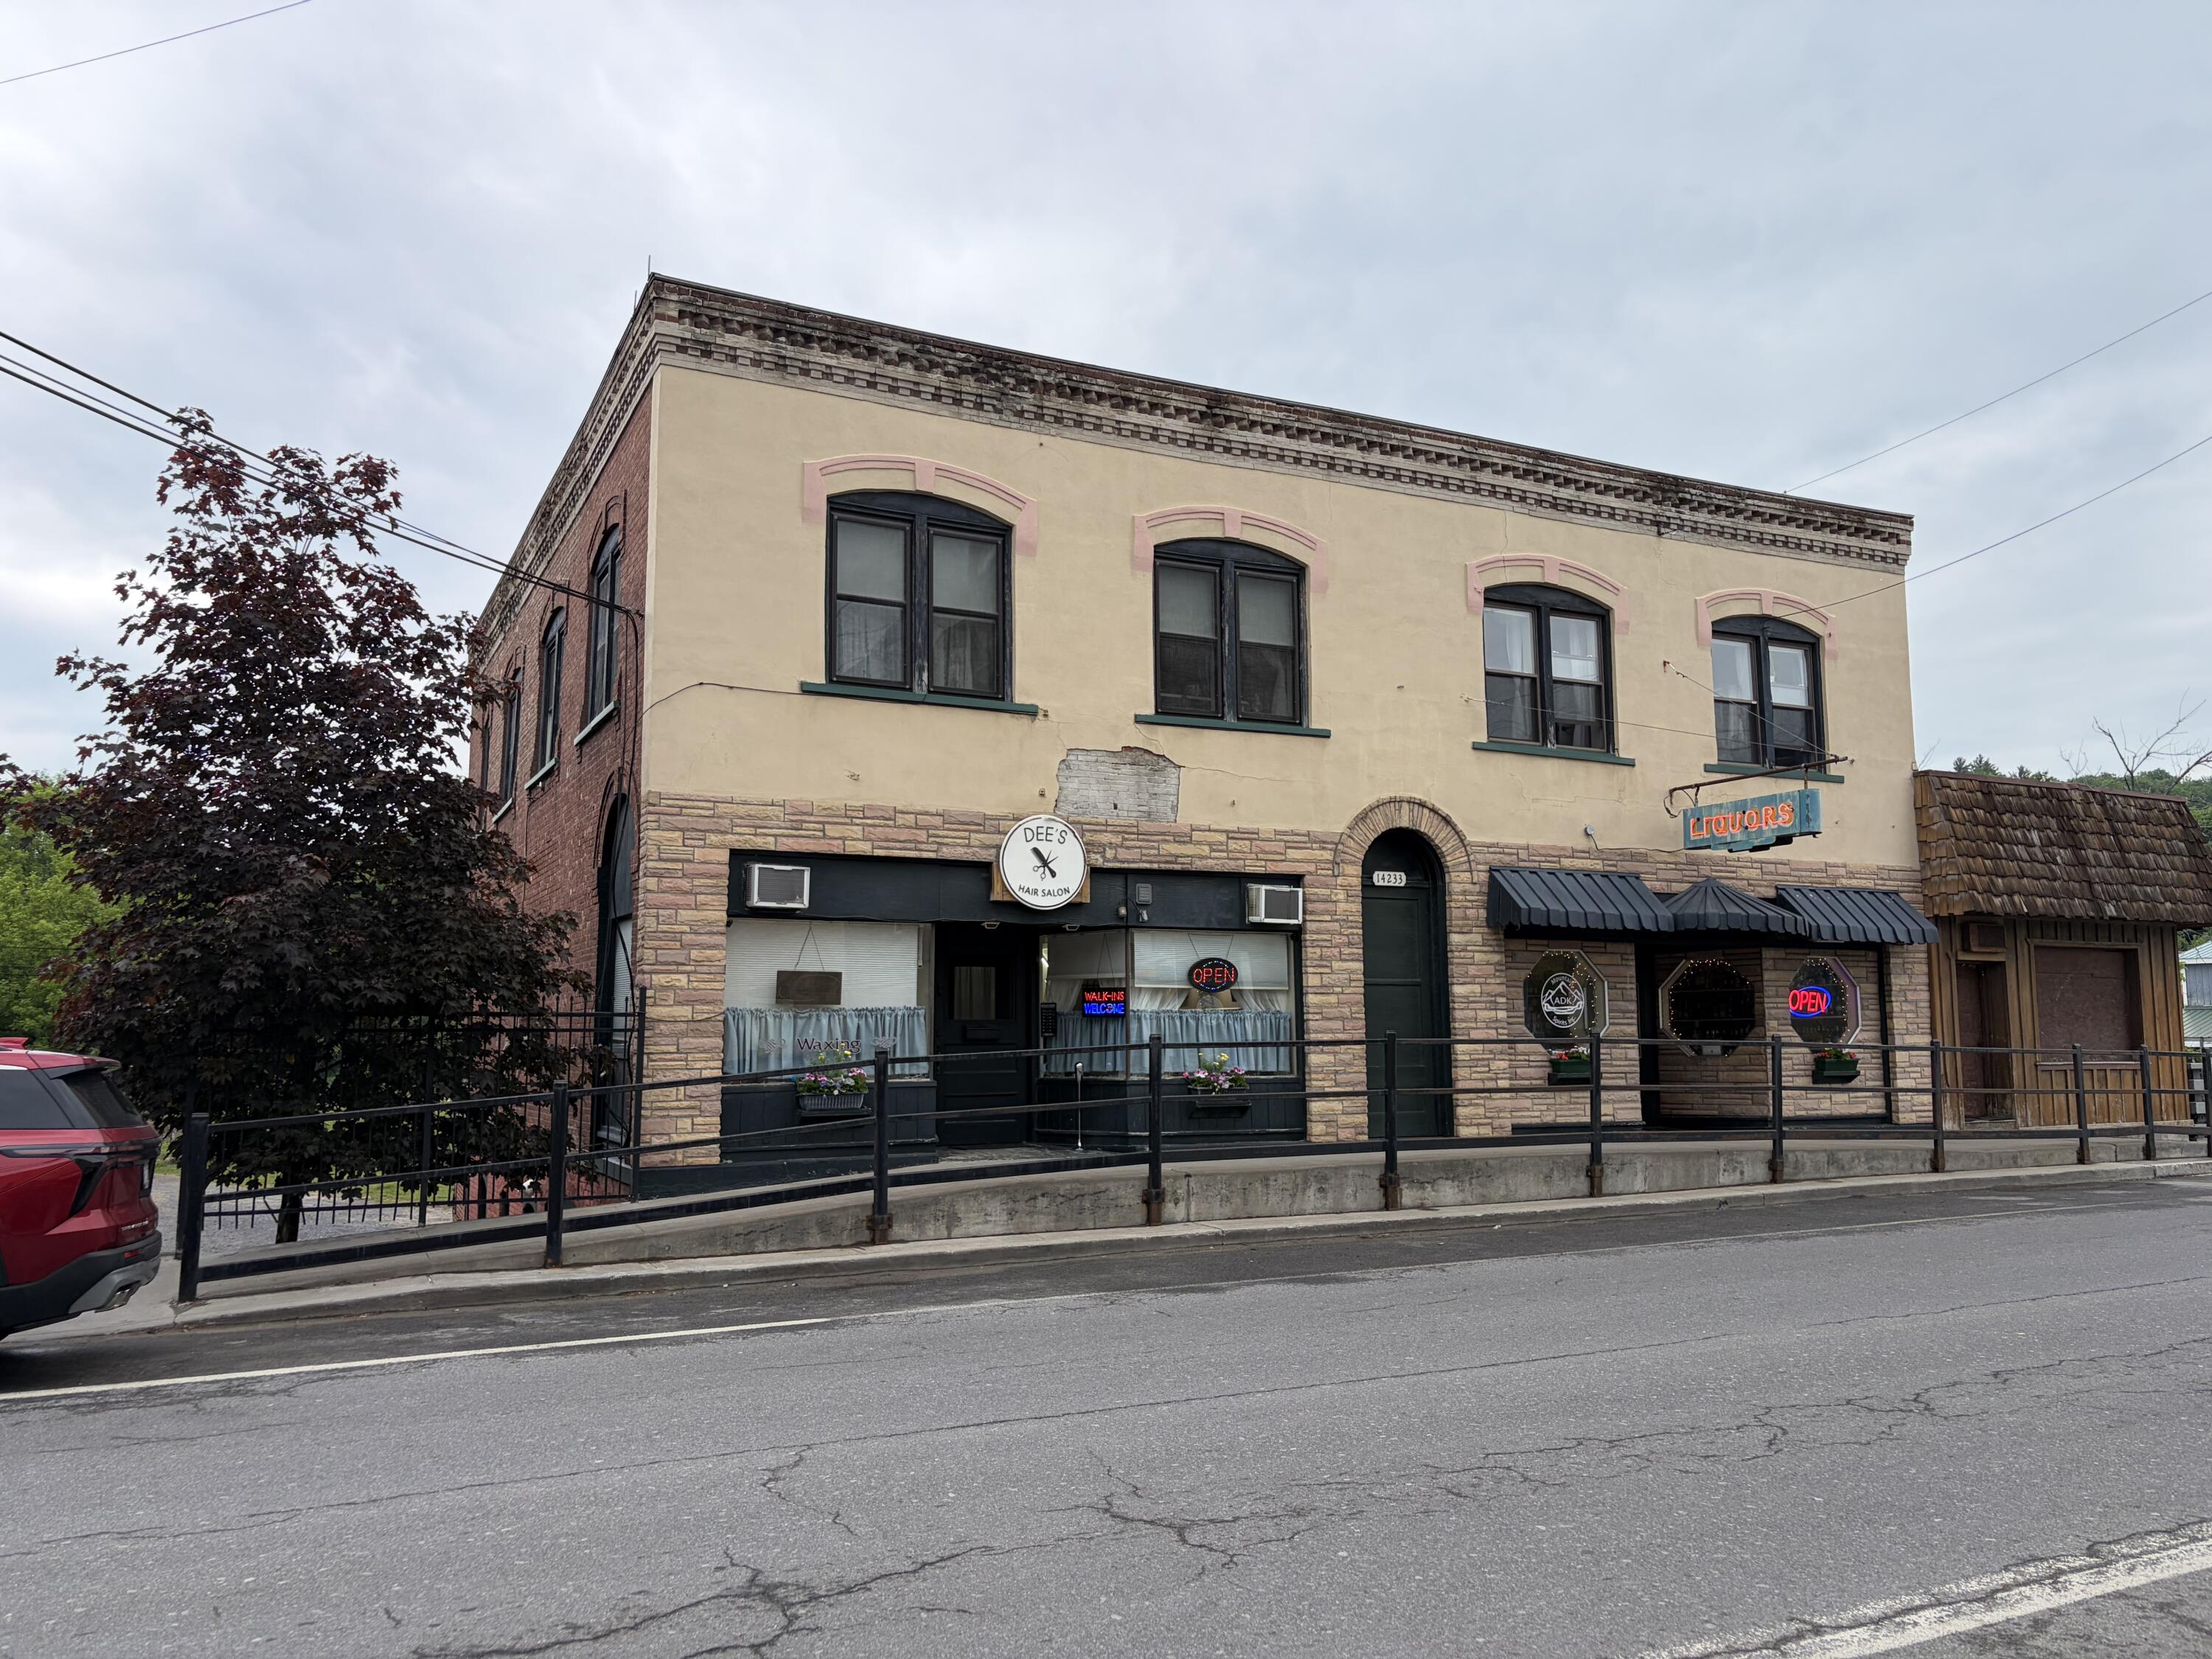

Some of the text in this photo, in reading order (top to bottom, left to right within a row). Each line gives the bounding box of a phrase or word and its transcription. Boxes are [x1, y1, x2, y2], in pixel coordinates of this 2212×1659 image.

[1690, 803, 1794, 840] LIQUORS
[1024, 826, 1068, 844] DEE'S
[1377, 873, 1402, 885] 14233
[1018, 885, 1070, 897] HAIR SALON
[1193, 967, 1235, 983] OPEN
[1084, 991, 1124, 1001] WALK-INS
[1789, 990, 1827, 1012] OPEN
[1084, 1003, 1124, 1014] WELCOME
[1552, 1015, 1568, 1026] Spirits
[797, 1037, 861, 1054] Waxing
